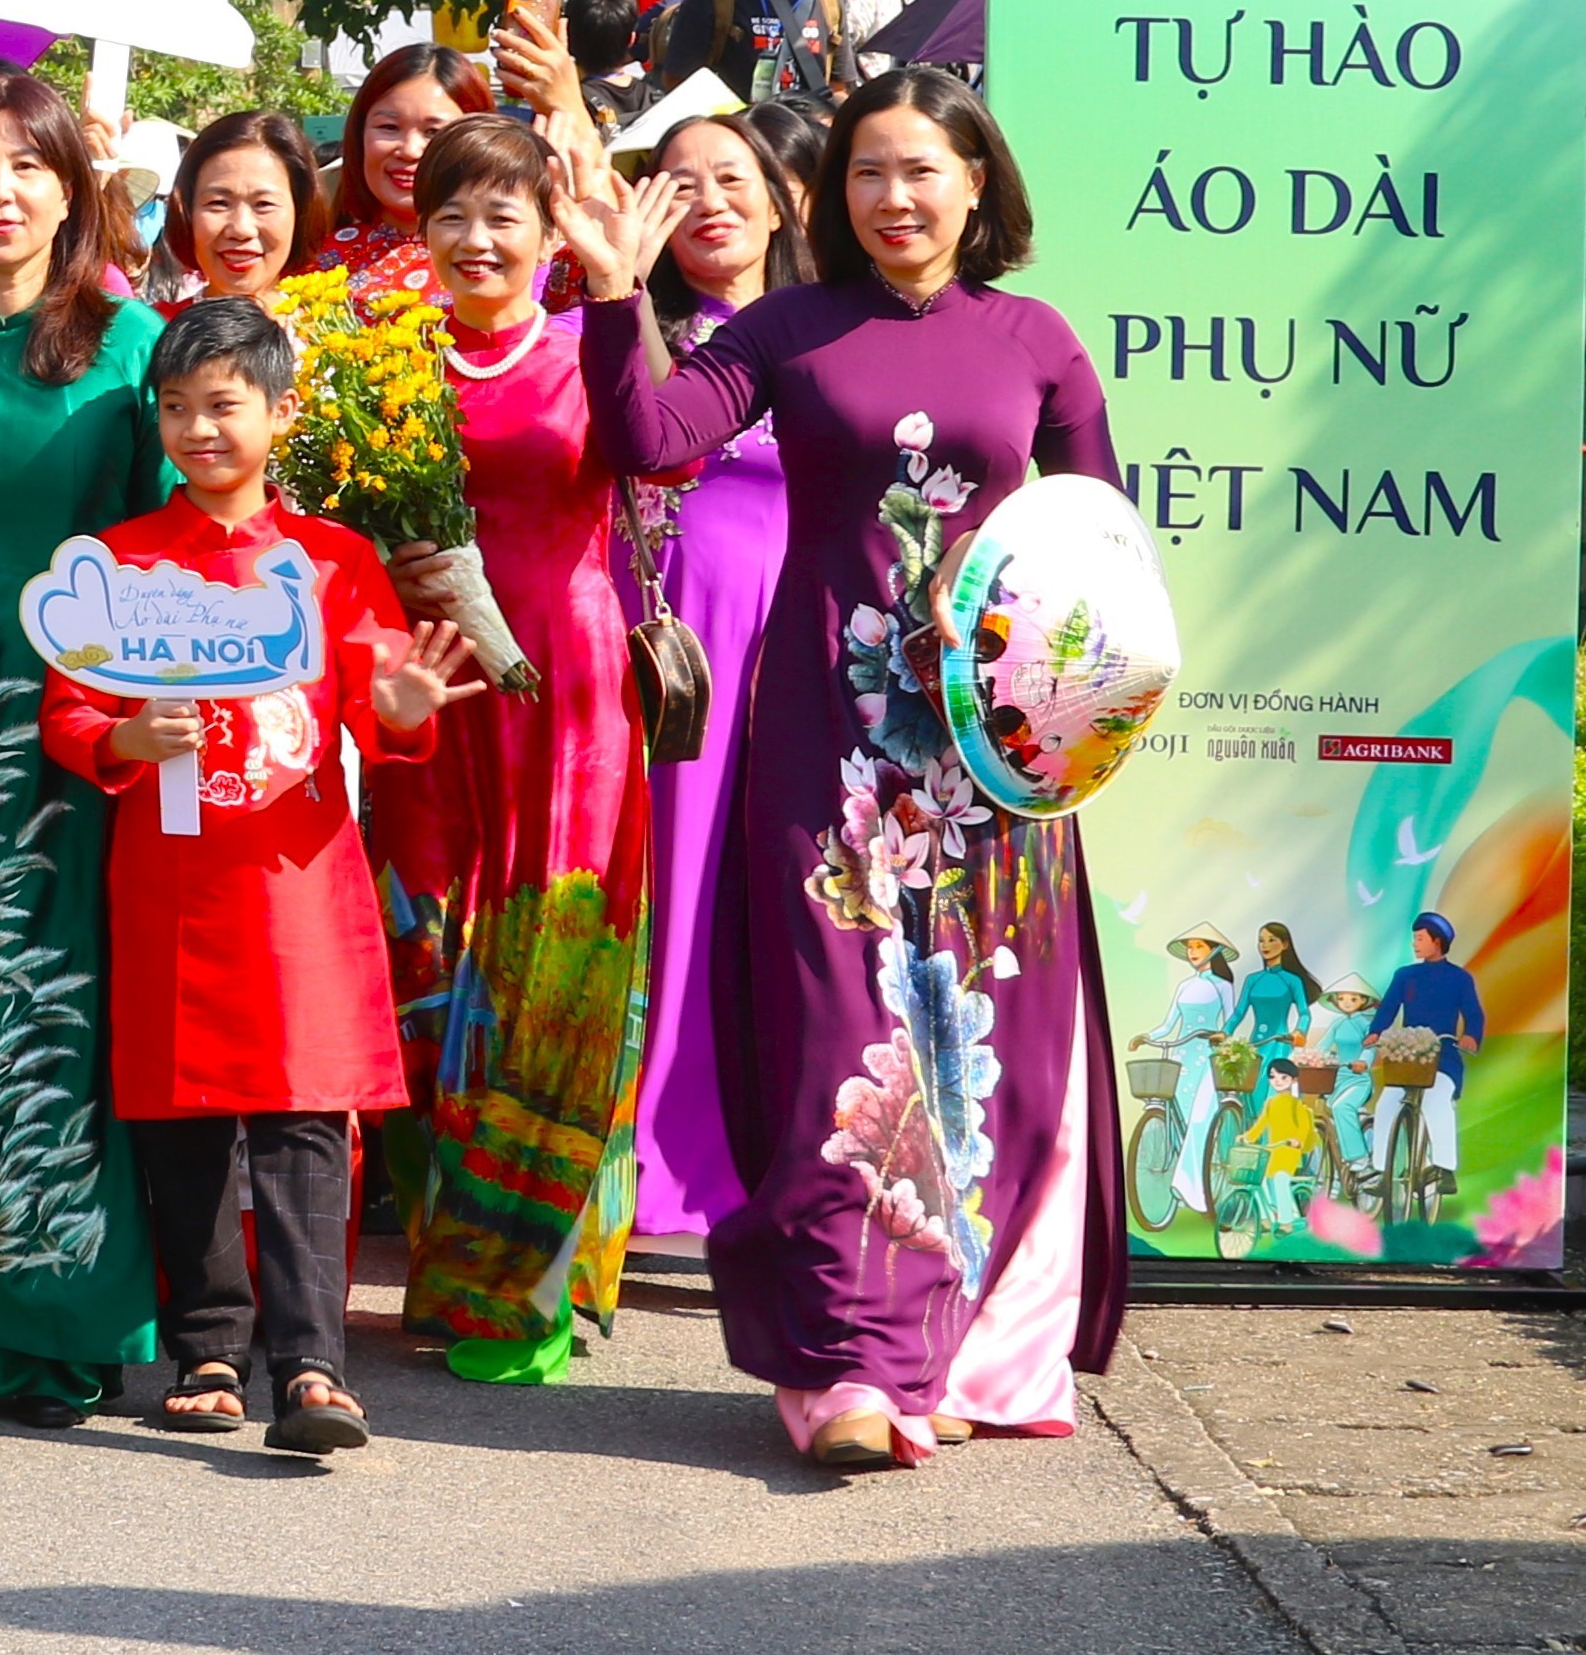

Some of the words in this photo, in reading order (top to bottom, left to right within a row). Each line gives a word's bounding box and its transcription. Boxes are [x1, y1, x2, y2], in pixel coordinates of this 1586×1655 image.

[1115, 9, 1246, 100] TỰ
[1263, 4, 1461, 90] HÀO
[1125, 149, 1257, 234] ÁO
[1285, 154, 1445, 238] DÀI
[1109, 314, 1295, 399] PHỤ
[1325, 305, 1469, 388] NỮ
[1125, 447, 1263, 546] IỆT
[1288, 467, 1501, 543] NAM
[121, 633, 186, 662] HÀ
[1179, 692, 1224, 710] ĐƠN
[1229, 694, 1248, 714] VỊ
[1253, 689, 1314, 712] ĐỒNG
[1319, 691, 1379, 714] HÀNH
[1343, 743, 1445, 760] AGRIBANK
